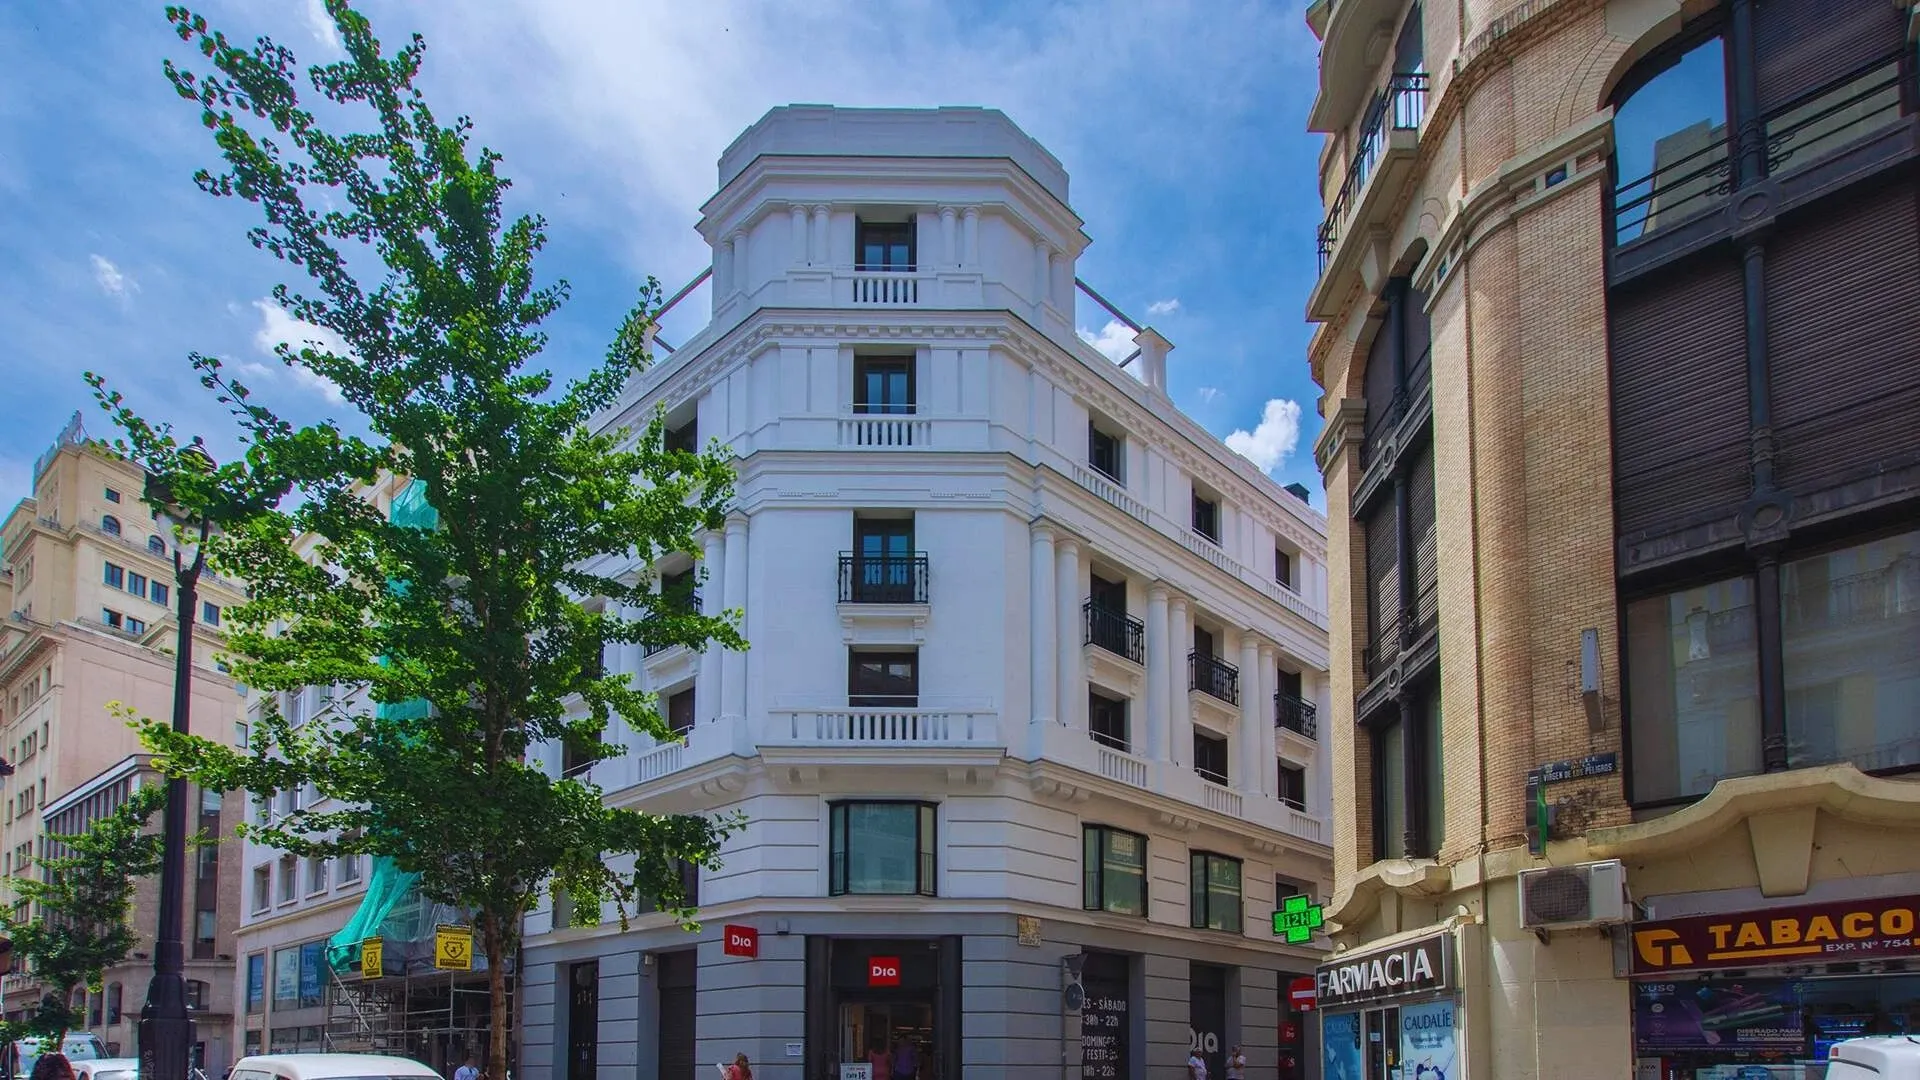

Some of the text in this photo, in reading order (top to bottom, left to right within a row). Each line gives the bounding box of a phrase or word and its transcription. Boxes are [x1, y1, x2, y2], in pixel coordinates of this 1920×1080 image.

[1708, 908, 1920, 949] TABACO
[1825, 942, 1857, 952] EXP.
[1882, 938, 1911, 948] 754
[1317, 948, 1434, 999] FARMACIA
